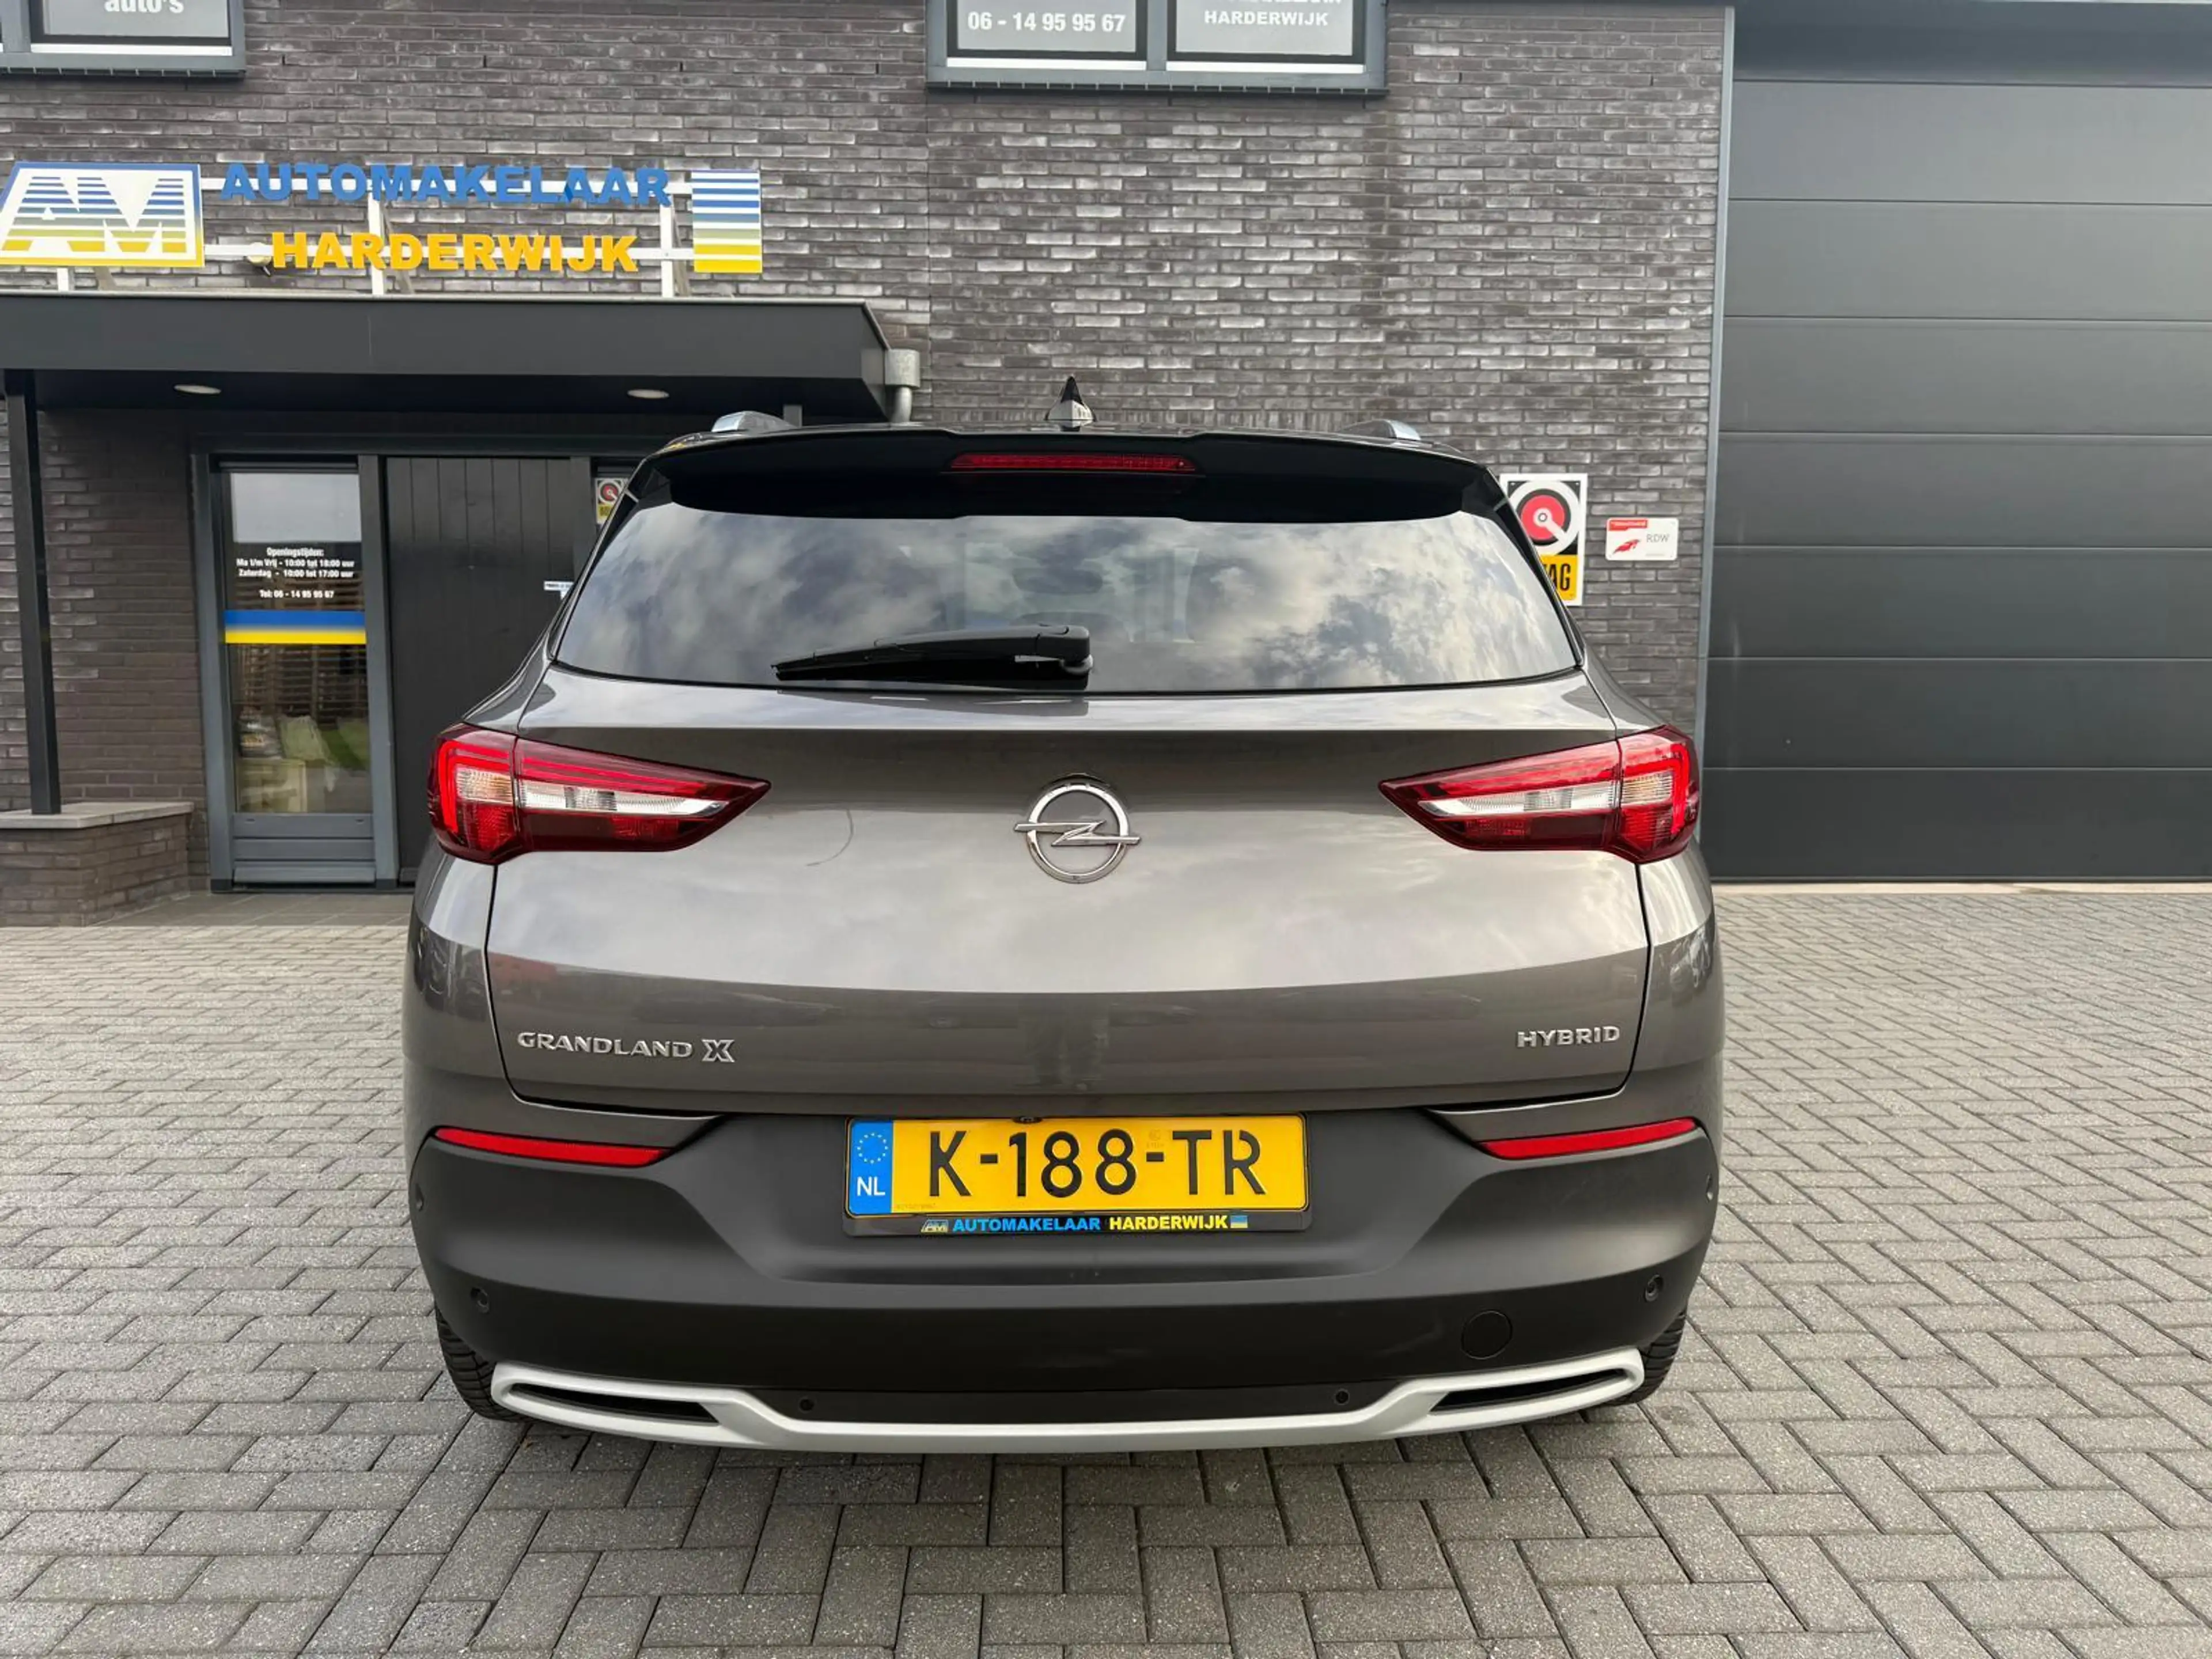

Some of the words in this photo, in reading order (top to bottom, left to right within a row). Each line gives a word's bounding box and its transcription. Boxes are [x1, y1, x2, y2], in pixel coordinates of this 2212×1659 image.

[968, 11, 993, 30] 06
[1013, 12, 1036, 31] 14
[1042, 13, 1066, 31] 95
[1072, 13, 1096, 32] 95
[1101, 14, 1126, 32] 67
[1204, 10, 1328, 26] HARDERWIJK
[220, 162, 672, 206] AUTOMAKELAAR
[271, 232, 638, 272] HARDERWIJK
[1646, 533, 1670, 543] RDW
[1543, 563, 1571, 591] AG
[1517, 1025, 1620, 1047] HYBRID
[518, 1032, 692, 1058] GRANDLAND
[701, 1039, 736, 1063] X
[929, 1128, 1266, 1198] K-188-TR
[857, 1177, 886, 1196] NL
[952, 1217, 1101, 1232] AUTOMAKELAAR
[1109, 1215, 1228, 1230] HARDERWIJK
